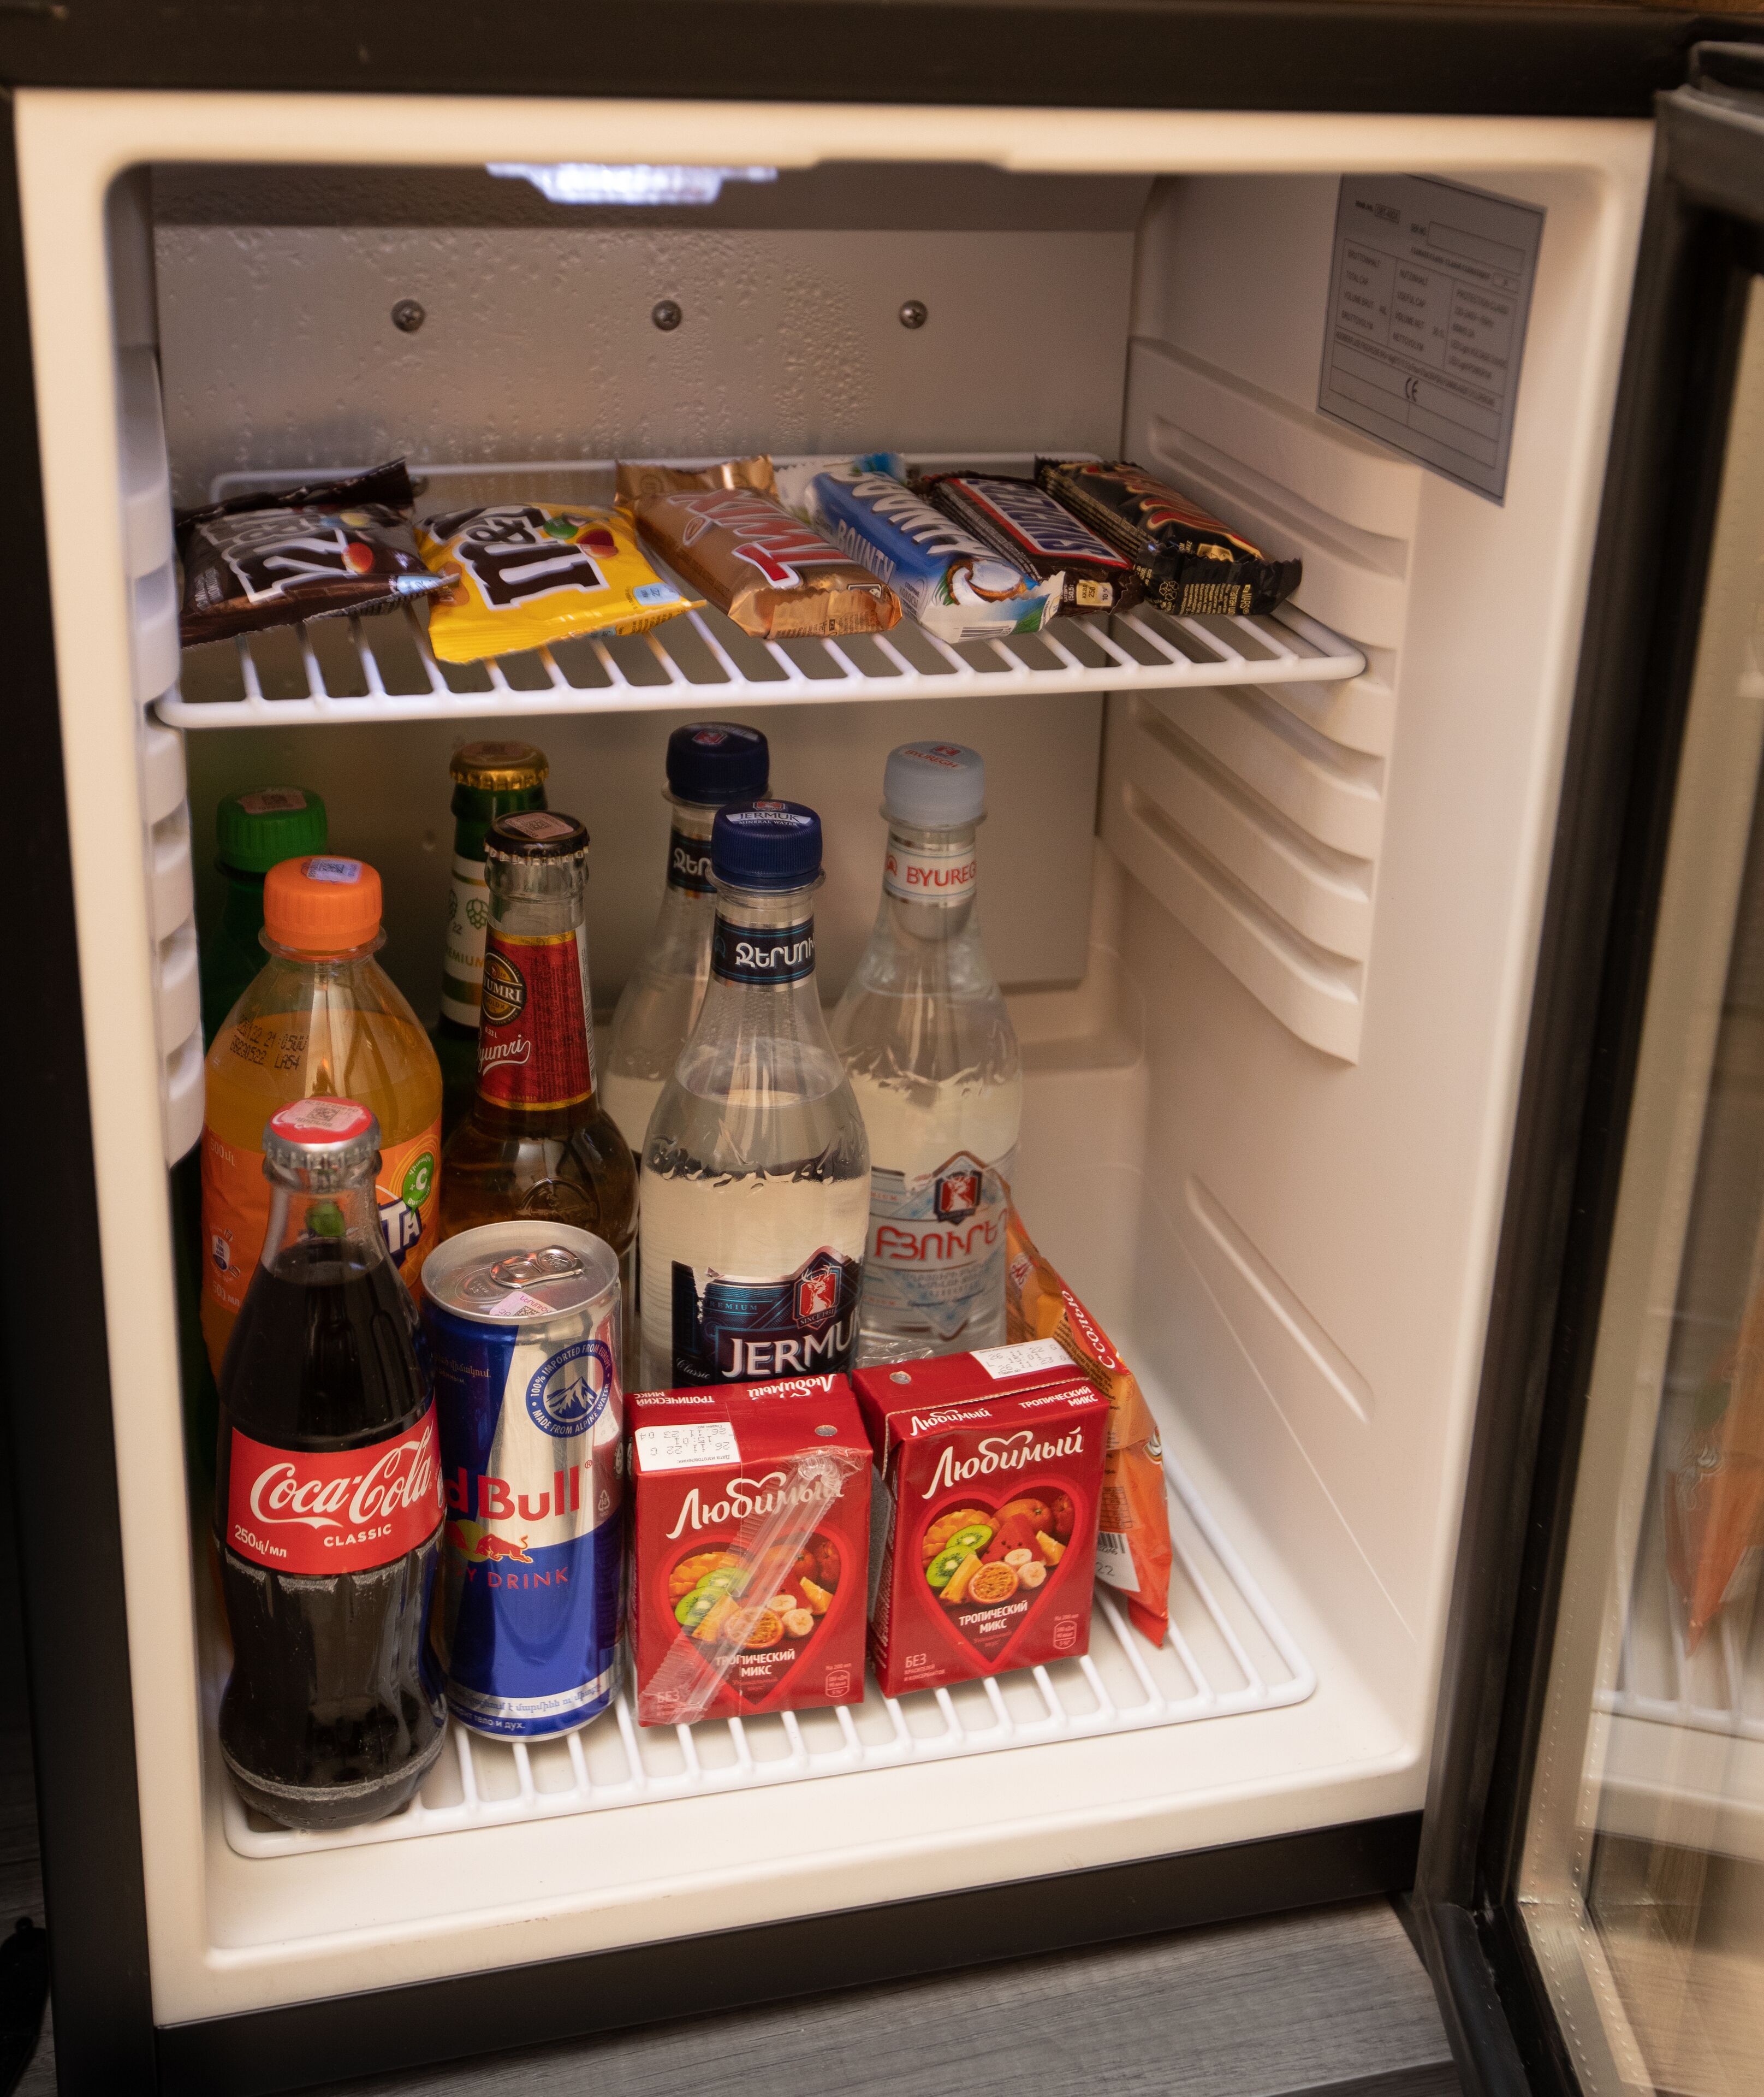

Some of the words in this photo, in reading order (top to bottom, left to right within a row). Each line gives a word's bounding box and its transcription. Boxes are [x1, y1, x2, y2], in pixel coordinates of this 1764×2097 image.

[904, 750, 959, 768] BYUREGH
[735, 810, 801, 824] JERMUK
[484, 975, 522, 1004] YUMRI
[800, 1314, 821, 1326] SINCE
[721, 1313, 860, 1379] JERMU
[530, 1376, 546, 1397] 100%
[542, 1347, 581, 1376] IMPORTED
[581, 1343, 599, 1354] FROM
[598, 1347, 611, 1370] EUROPE
[676, 1356, 711, 1380] Classic
[747, 1373, 838, 1401] Любимый
[1018, 1385, 1092, 1410] ТРОПИЧЕСКИЙ
[532, 1409, 552, 1429] MADE
[550, 1424, 573, 1435] FROM
[575, 1412, 598, 1433] ALPINE
[596, 1383, 609, 1411] WATER
[636, 1395, 715, 1406] ТРОПИЧЕСКИЙ
[1067, 1394, 1099, 1407] МИКС
[910, 1407, 993, 1436] Любимый
[250, 1419, 433, 1530] Coca-Cola
[922, 1426, 1084, 1500] Любимый
[478, 1465, 580, 1521] Bull
[323, 1523, 393, 1548] CLASSIC
[488, 1567, 569, 1590] DRINK
[958, 1600, 1029, 1627] ТРОПИЧЕСКИЙ
[979, 1618, 1008, 1634] МИКС
[741, 1664, 773, 1678] МИКС
[905, 1652, 927, 1669] БЕЗ
[504, 1721, 526, 1732] дух.
